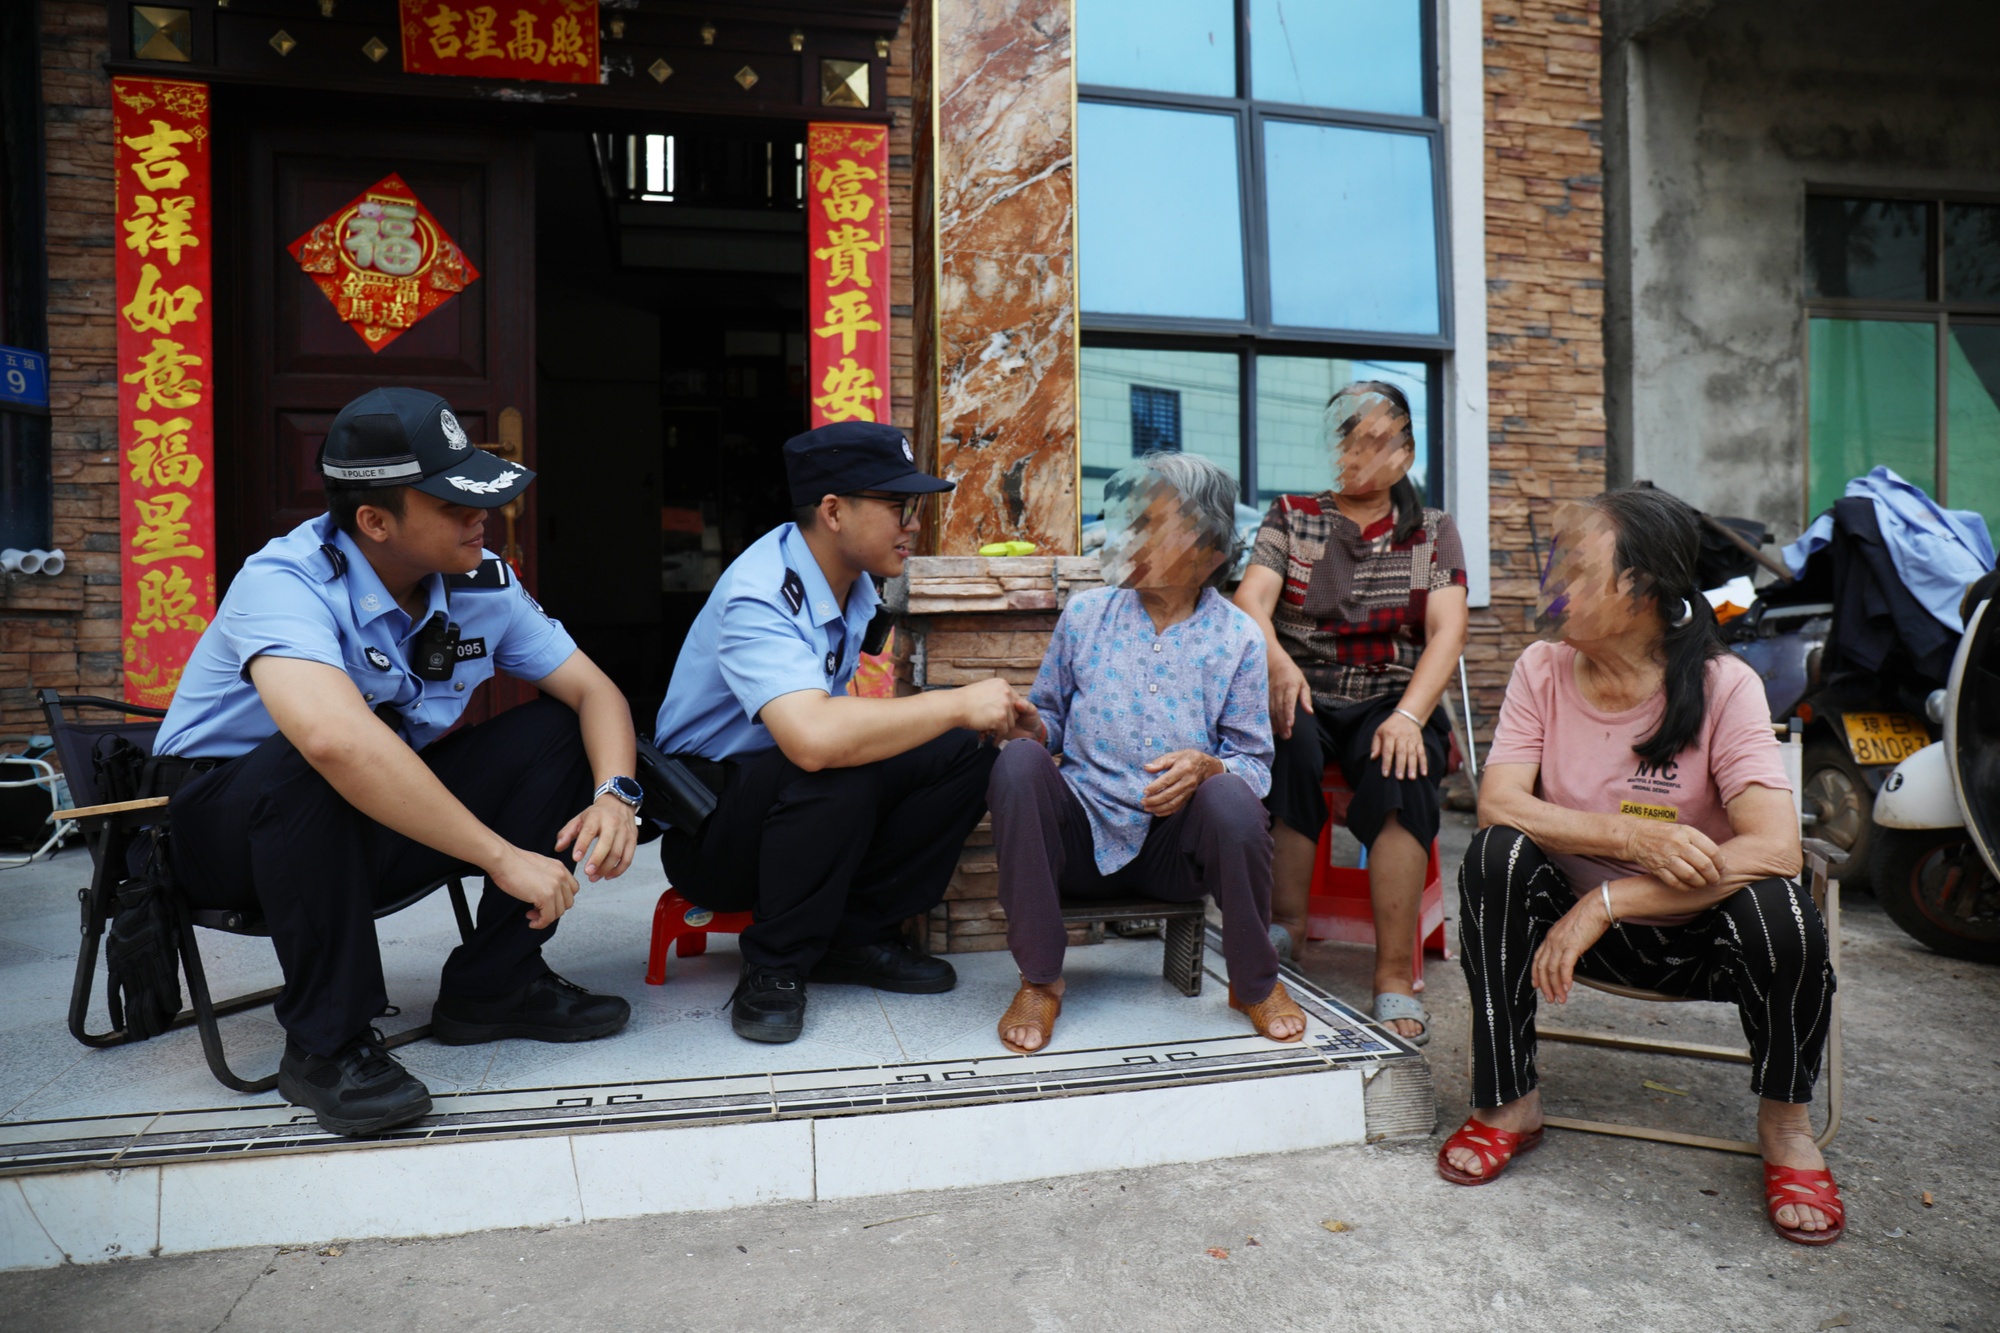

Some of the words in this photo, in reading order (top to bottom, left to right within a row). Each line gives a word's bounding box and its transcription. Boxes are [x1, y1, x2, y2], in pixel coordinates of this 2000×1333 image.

[343, 203, 422, 275] 福
[814, 160, 883, 422] 富貴平安
[5, 354, 36, 371] 五组
[7, 369, 26, 394] 9
[122, 119, 208, 639] 吉祥如意福星照
[348, 469, 376, 478] POLICE
[456, 642, 482, 658] 095
[1635, 761, 1678, 780] NYC
[1621, 804, 1643, 815] JEANS
[1643, 807, 1676, 819] FASHION
